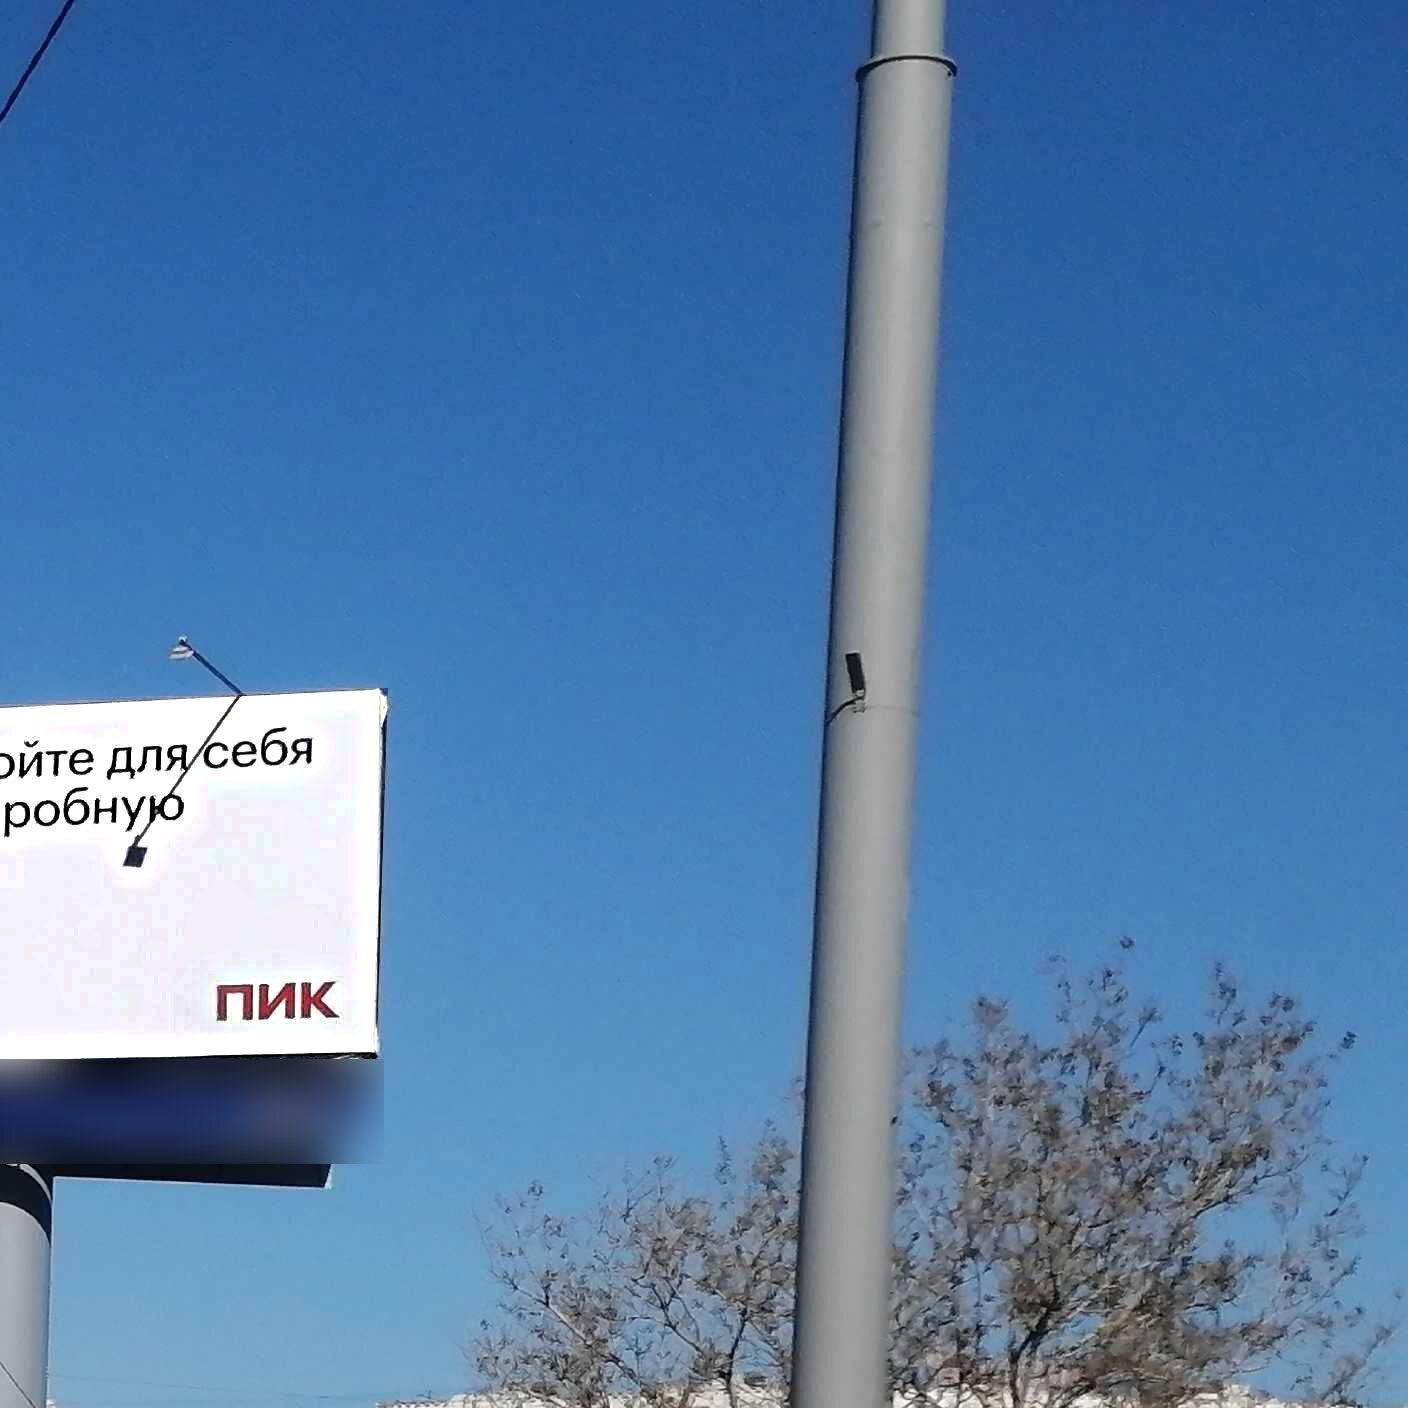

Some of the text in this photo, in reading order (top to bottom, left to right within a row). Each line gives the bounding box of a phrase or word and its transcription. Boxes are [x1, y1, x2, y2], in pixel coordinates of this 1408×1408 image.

[106, 742, 189, 779] для
[202, 726, 314, 769] себя
[216, 981, 341, 1022] ПИК
